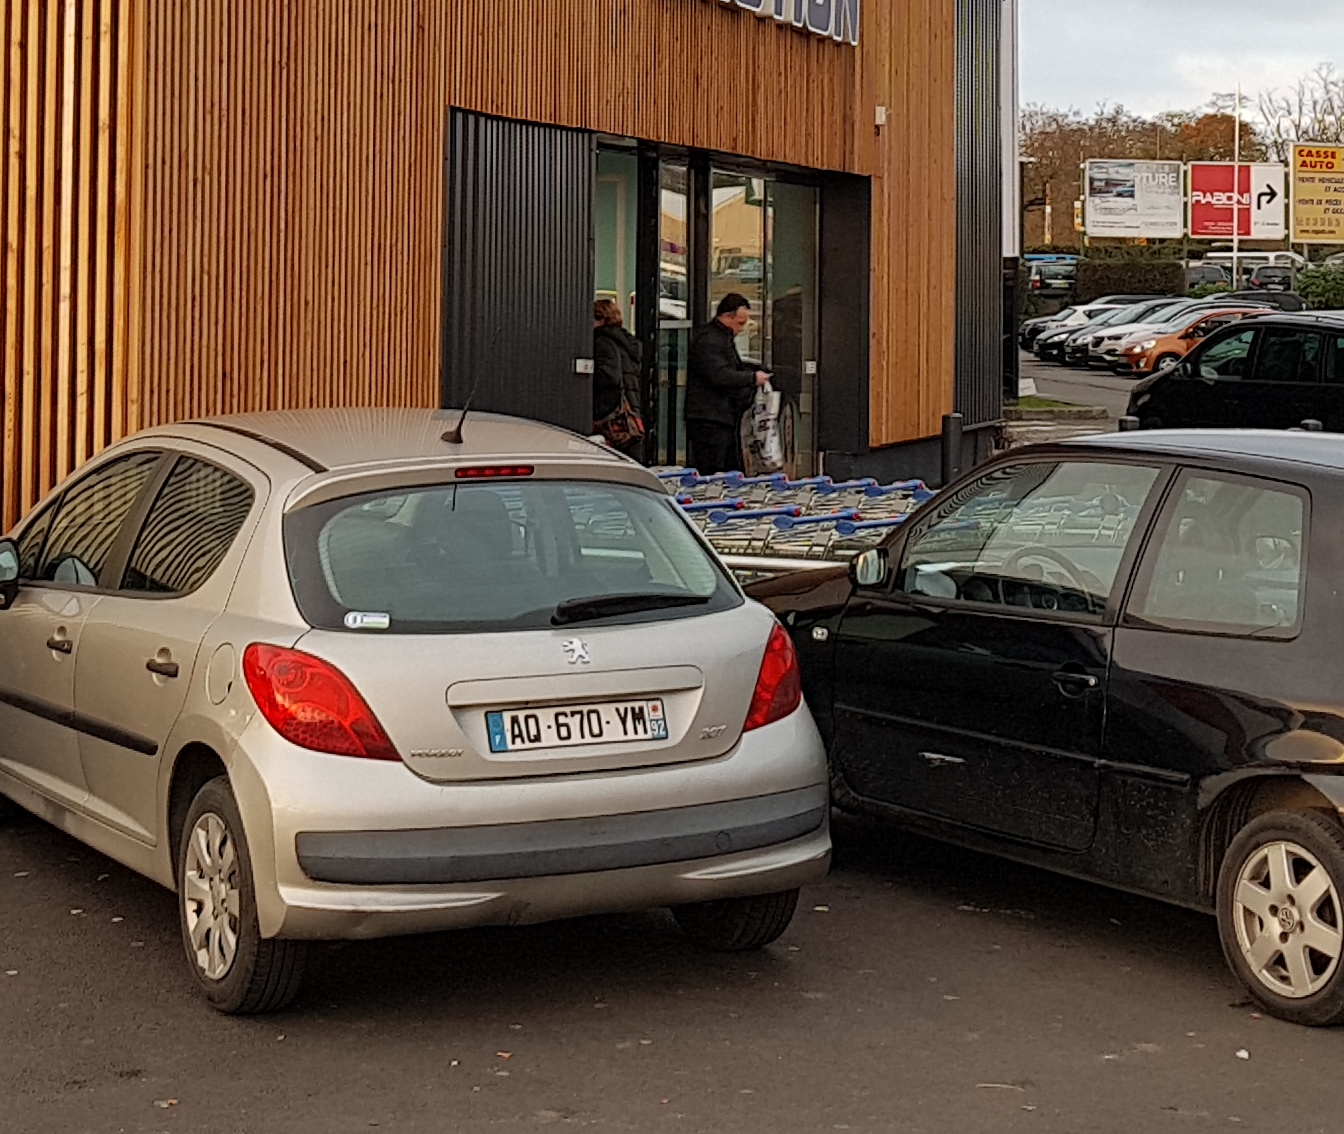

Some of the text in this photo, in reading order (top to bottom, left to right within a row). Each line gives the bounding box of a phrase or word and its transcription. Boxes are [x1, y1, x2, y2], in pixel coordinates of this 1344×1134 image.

[1298, 149, 1337, 159] CASSE
[1299, 160, 1335, 169] AUTO
[650, 719, 665, 737] 92
